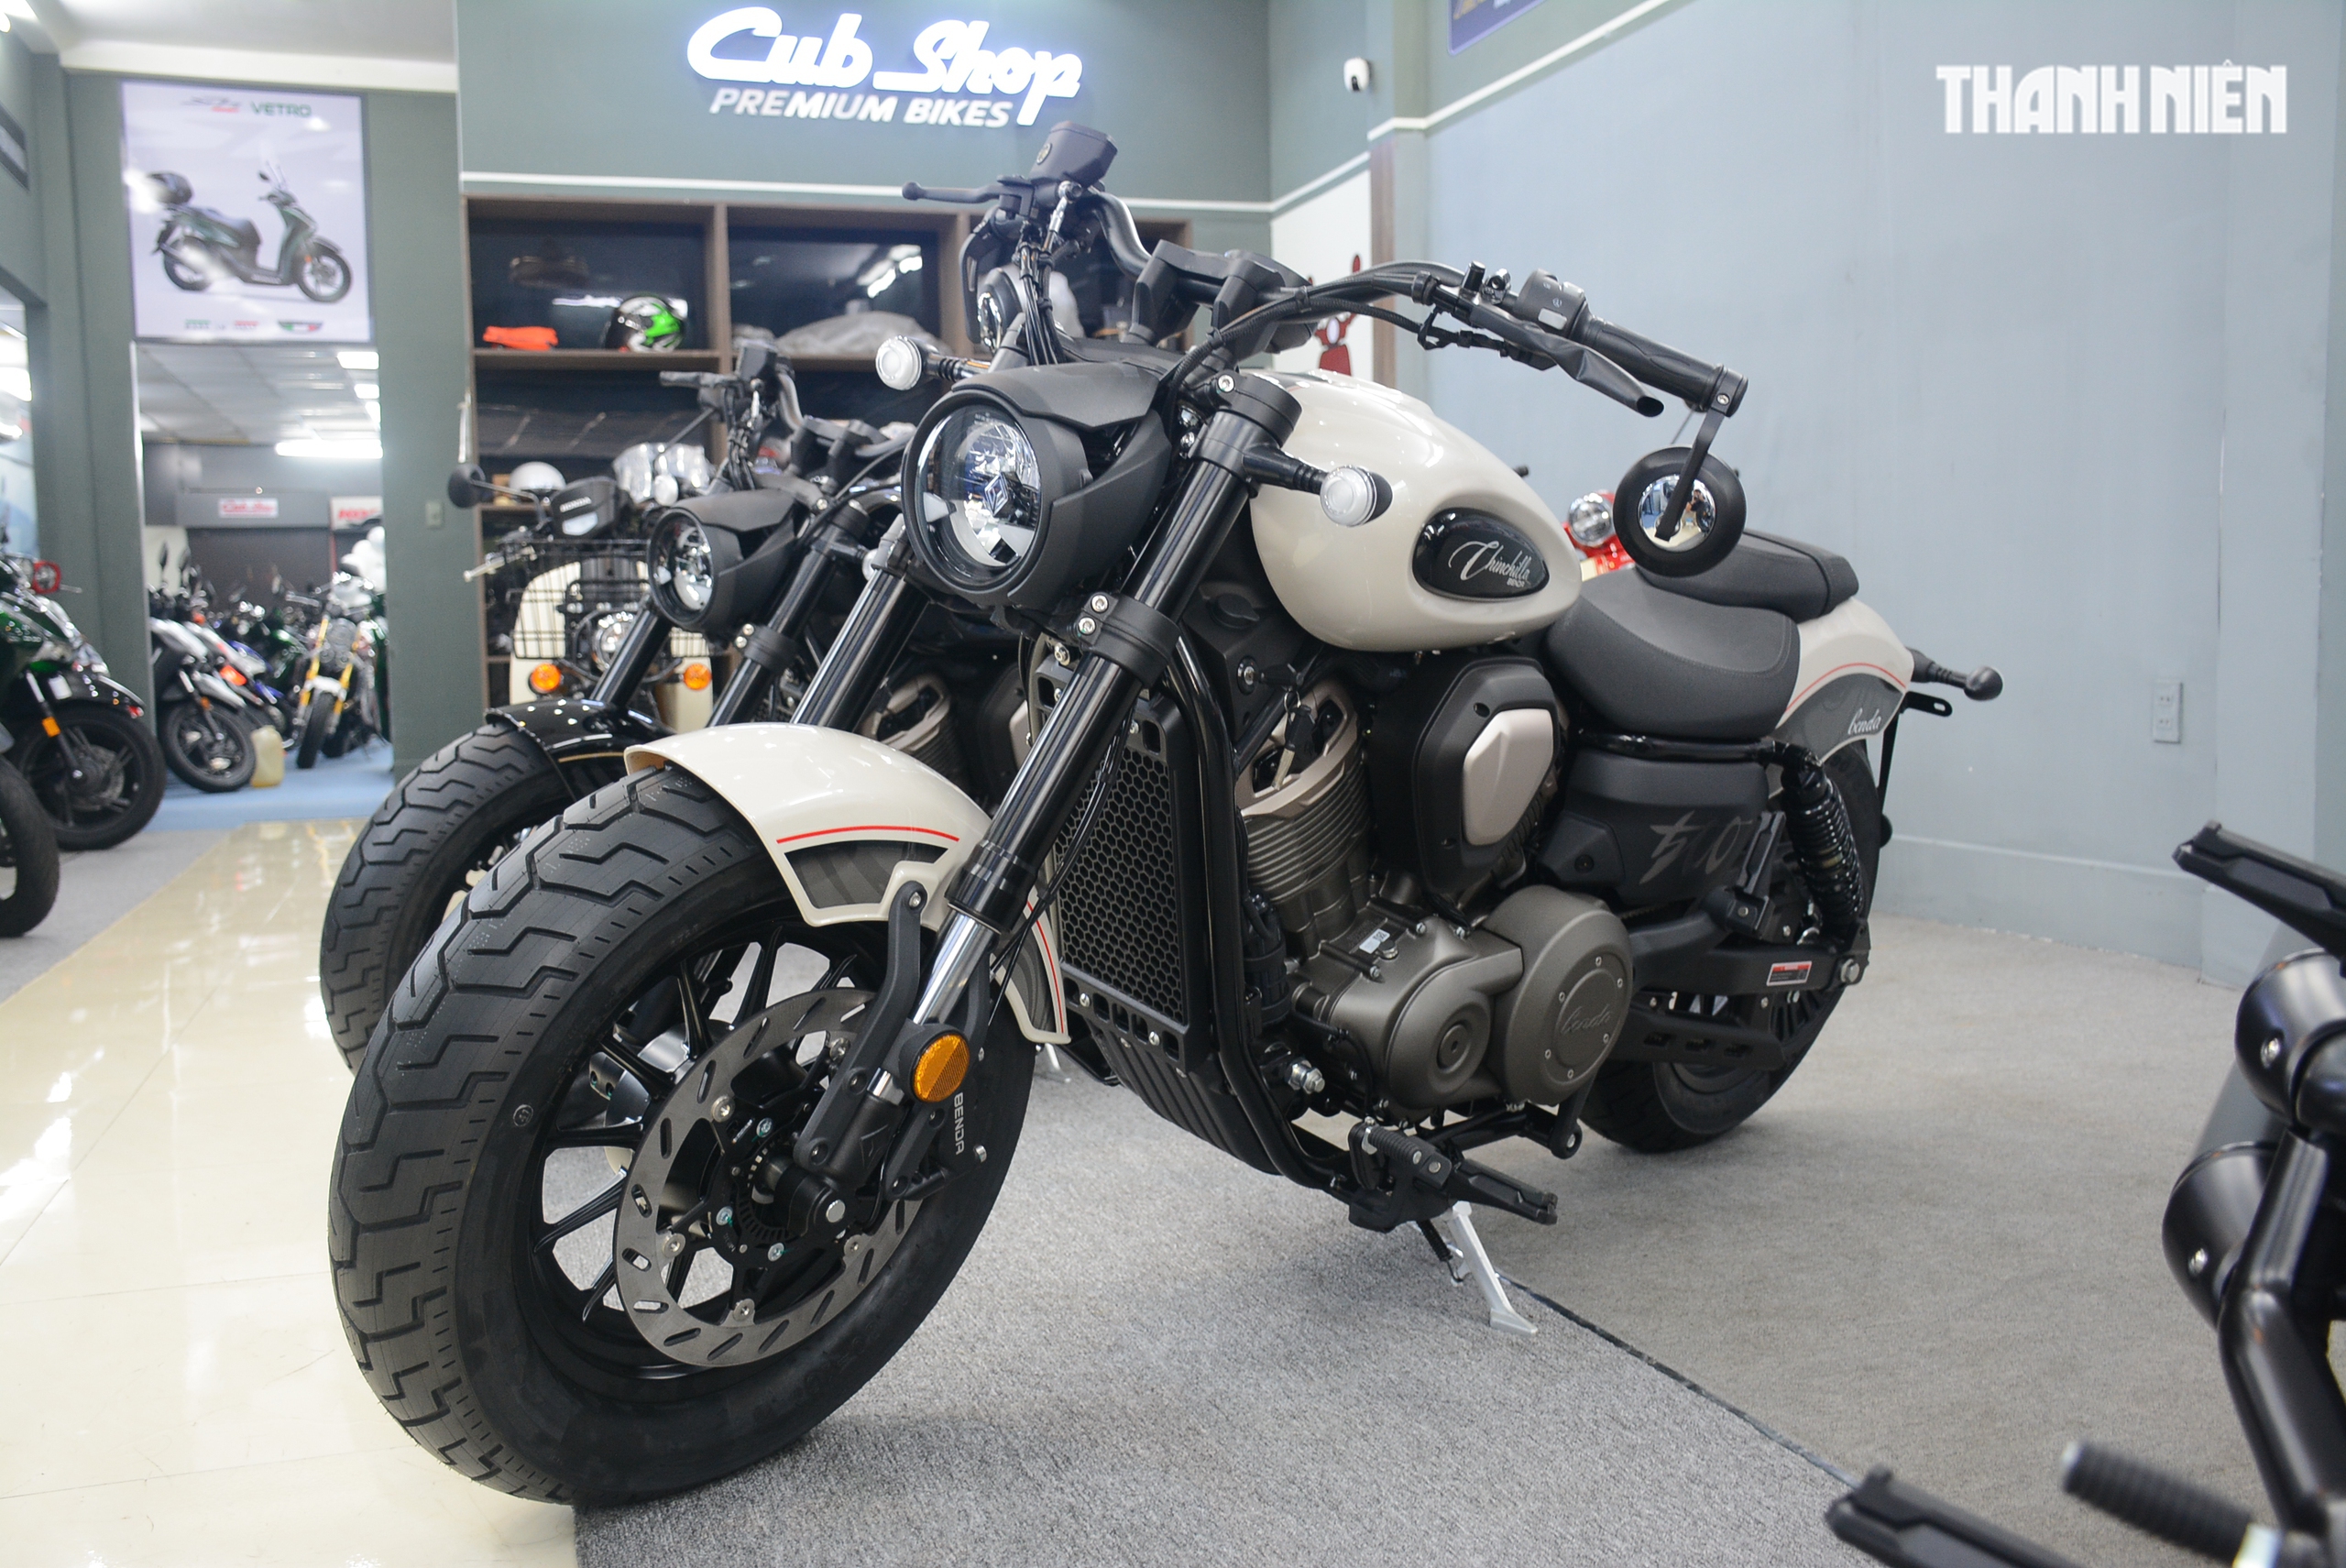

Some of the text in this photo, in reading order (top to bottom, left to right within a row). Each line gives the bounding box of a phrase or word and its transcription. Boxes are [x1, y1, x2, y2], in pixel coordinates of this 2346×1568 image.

[686, 5, 1083, 126] Cub Shop
[250, 101, 312, 118] VETRO
[708, 87, 1014, 129] PREMIUM BIKES
[1448, 540, 1531, 585] Chinchilla
[954, 1091, 965, 1156] BENDA
